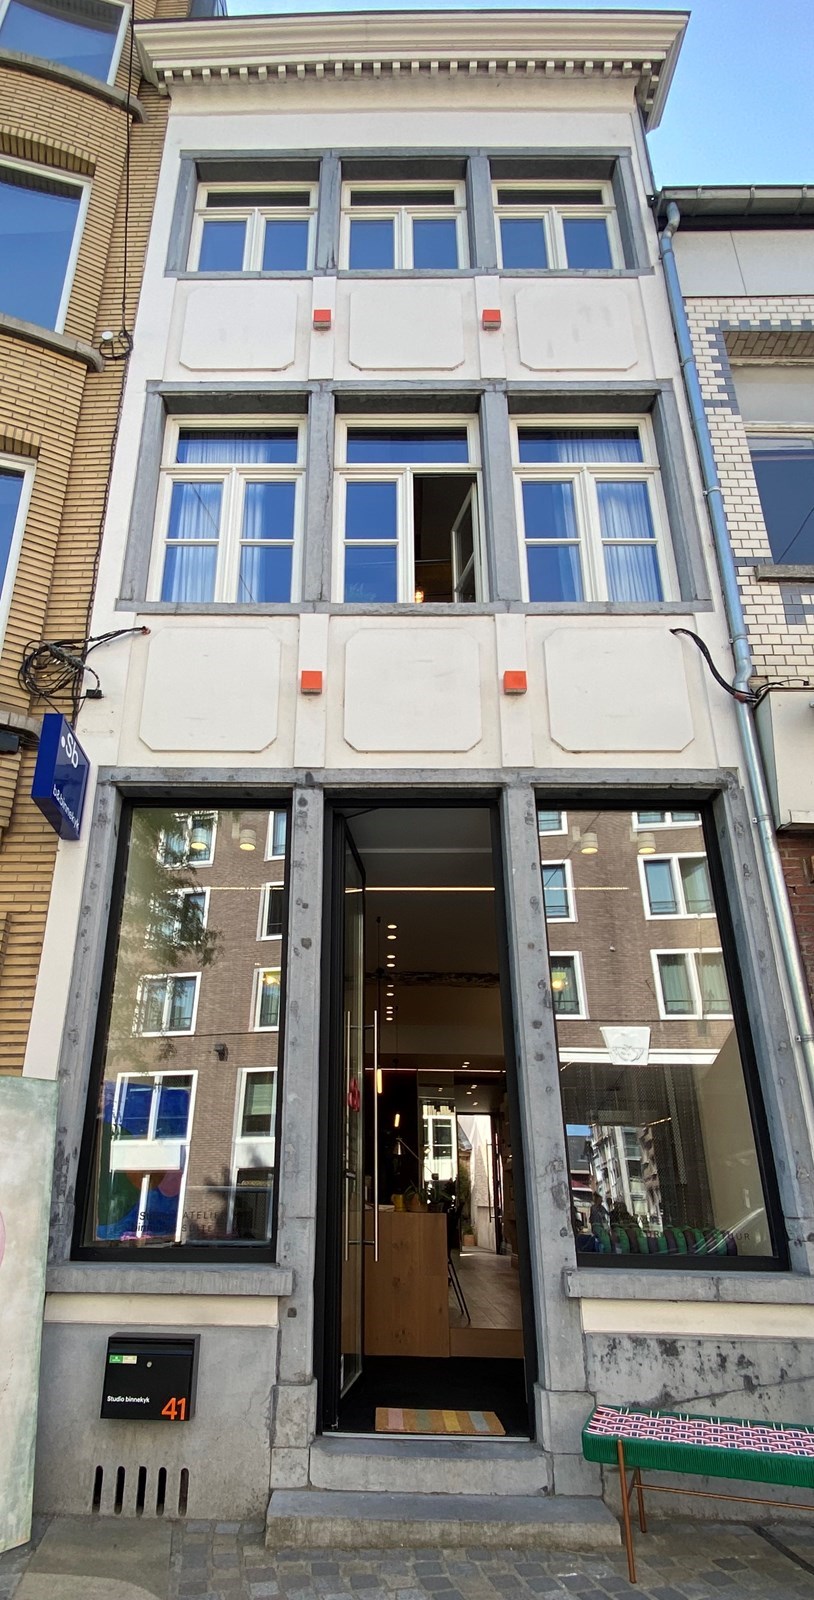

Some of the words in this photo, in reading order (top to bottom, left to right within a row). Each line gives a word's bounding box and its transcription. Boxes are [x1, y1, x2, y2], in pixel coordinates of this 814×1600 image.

[182, 1211, 224, 1220] ATELIE
[107, 1395, 124, 1403] Studio
[125, 1396, 150, 1404] binnekyk
[161, 1397, 186, 1420] 41
